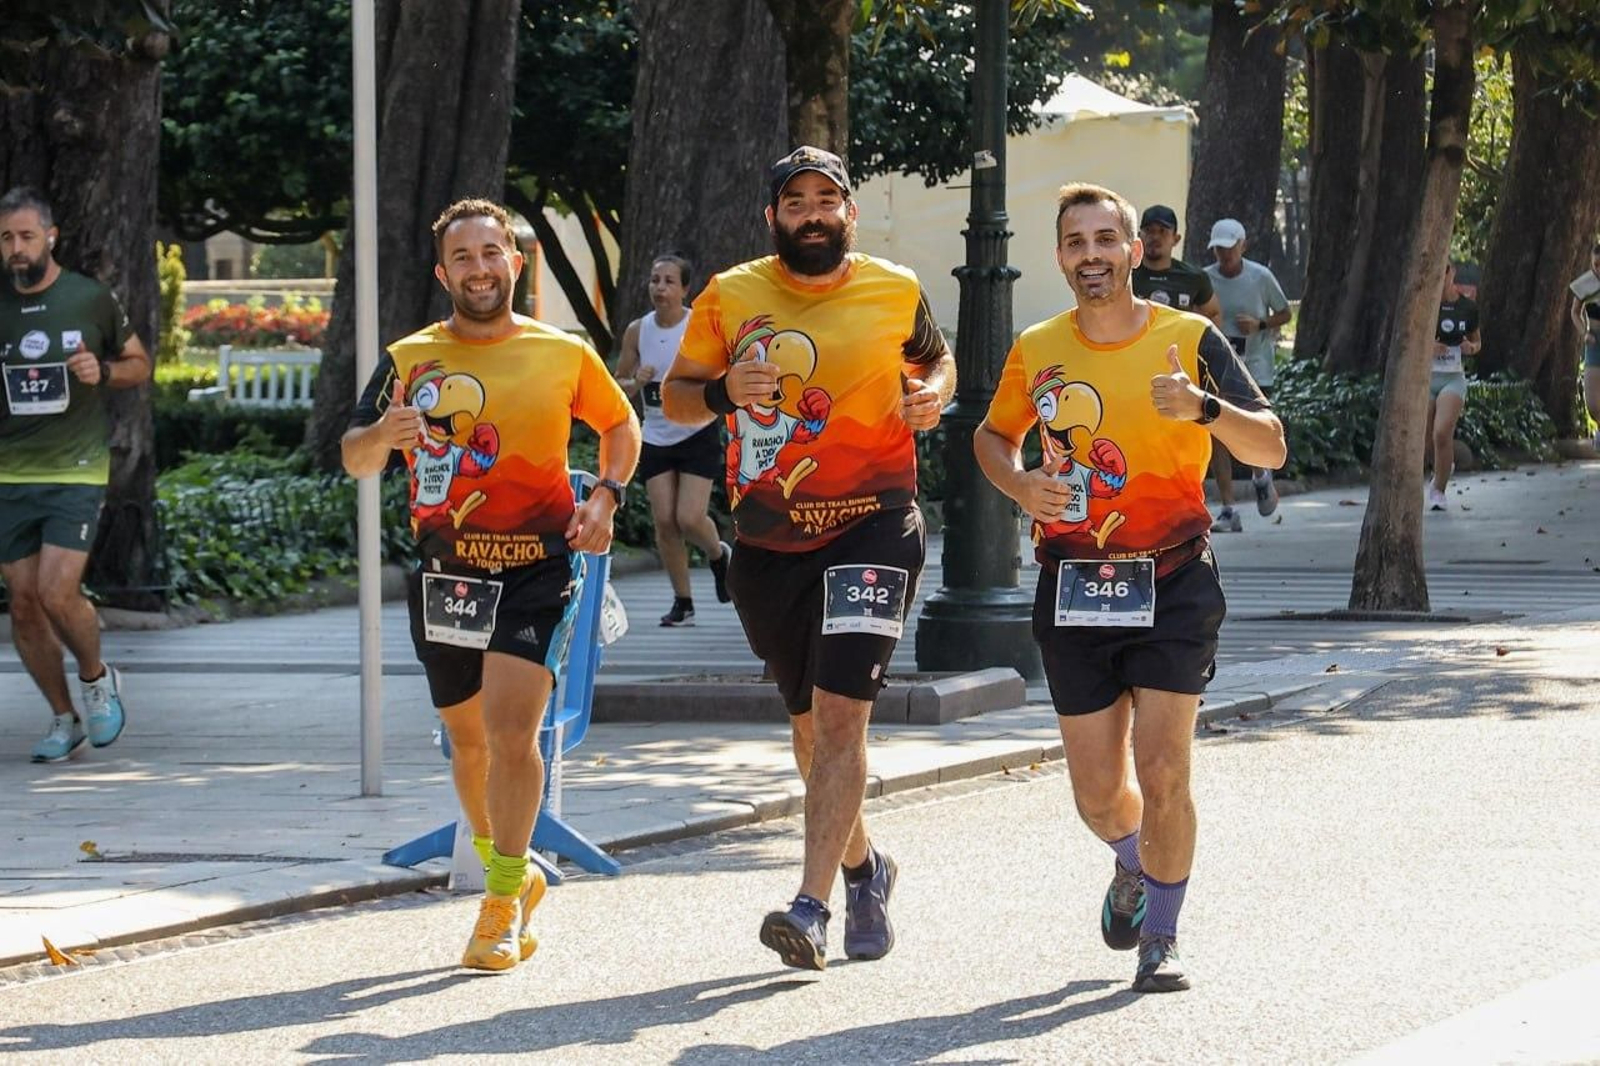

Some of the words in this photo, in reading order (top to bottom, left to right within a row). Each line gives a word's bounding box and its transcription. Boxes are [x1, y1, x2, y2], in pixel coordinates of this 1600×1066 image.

[20, 379, 49, 393] 127
[796, 502, 815, 510] CLUB
[827, 500, 847, 508] TRAIL
[463, 533, 481, 541] CLUB
[481, 533, 491, 541] DE
[493, 534, 511, 542] TRAIL
[455, 540, 548, 560] RAVACHOL
[1108, 552, 1127, 560] CLUB
[475, 559, 503, 569] TODO
[846, 586, 890, 604] 342
[1084, 581, 1130, 598] 346
[444, 596, 478, 617] 344
